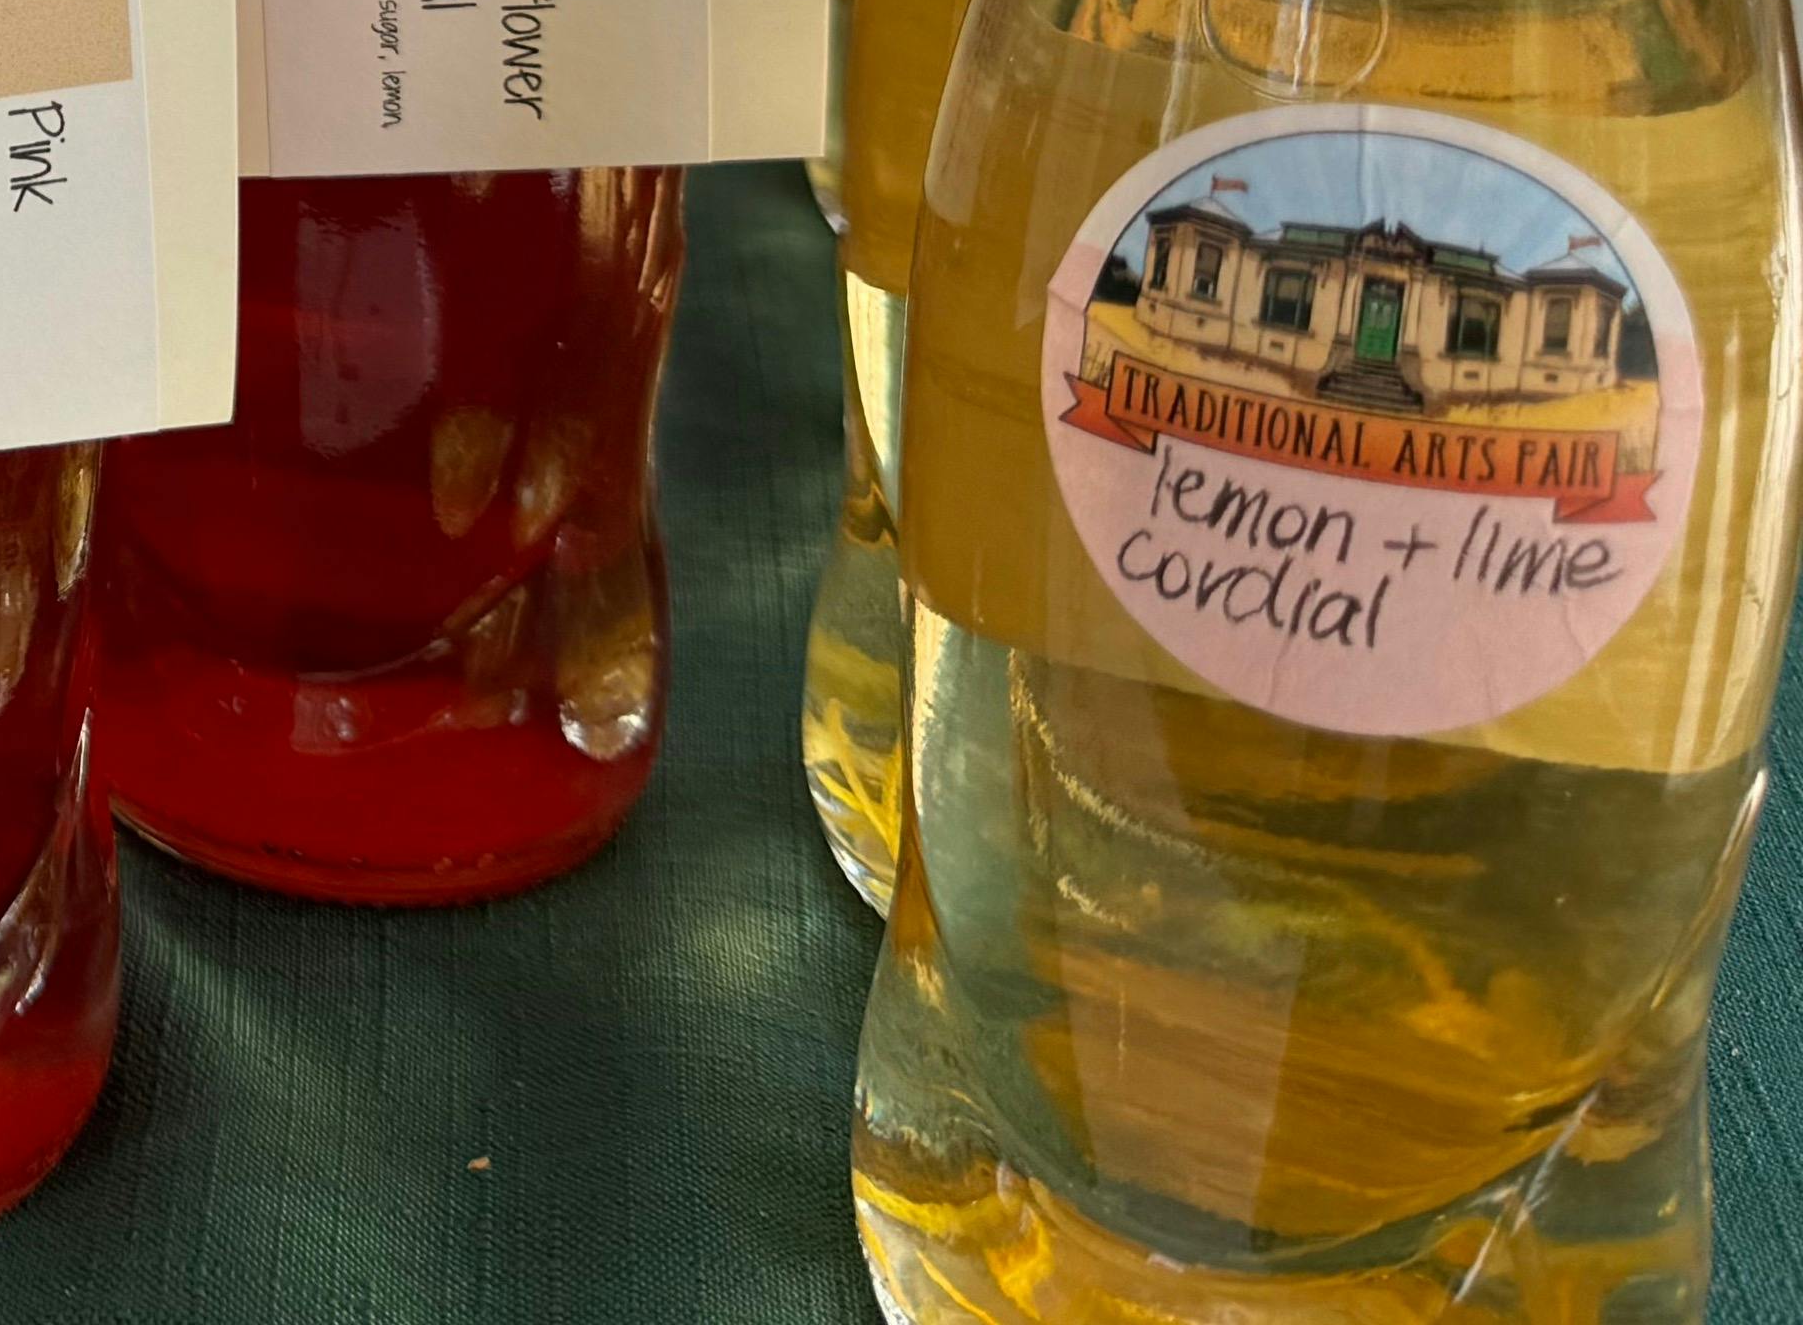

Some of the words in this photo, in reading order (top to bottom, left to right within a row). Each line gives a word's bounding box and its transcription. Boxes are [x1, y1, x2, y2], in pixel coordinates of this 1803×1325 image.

[9, 100, 67, 212] Pink
[1119, 364, 1371, 469] TRADITIONAL
[1394, 431, 1497, 482] ARTS
[1515, 439, 1603, 490] FAIR
[1151, 445, 1355, 564] lemon
[1383, 523, 1439, 572] +
[1453, 504, 1624, 597] lime
[1118, 530, 1389, 649] cordial
